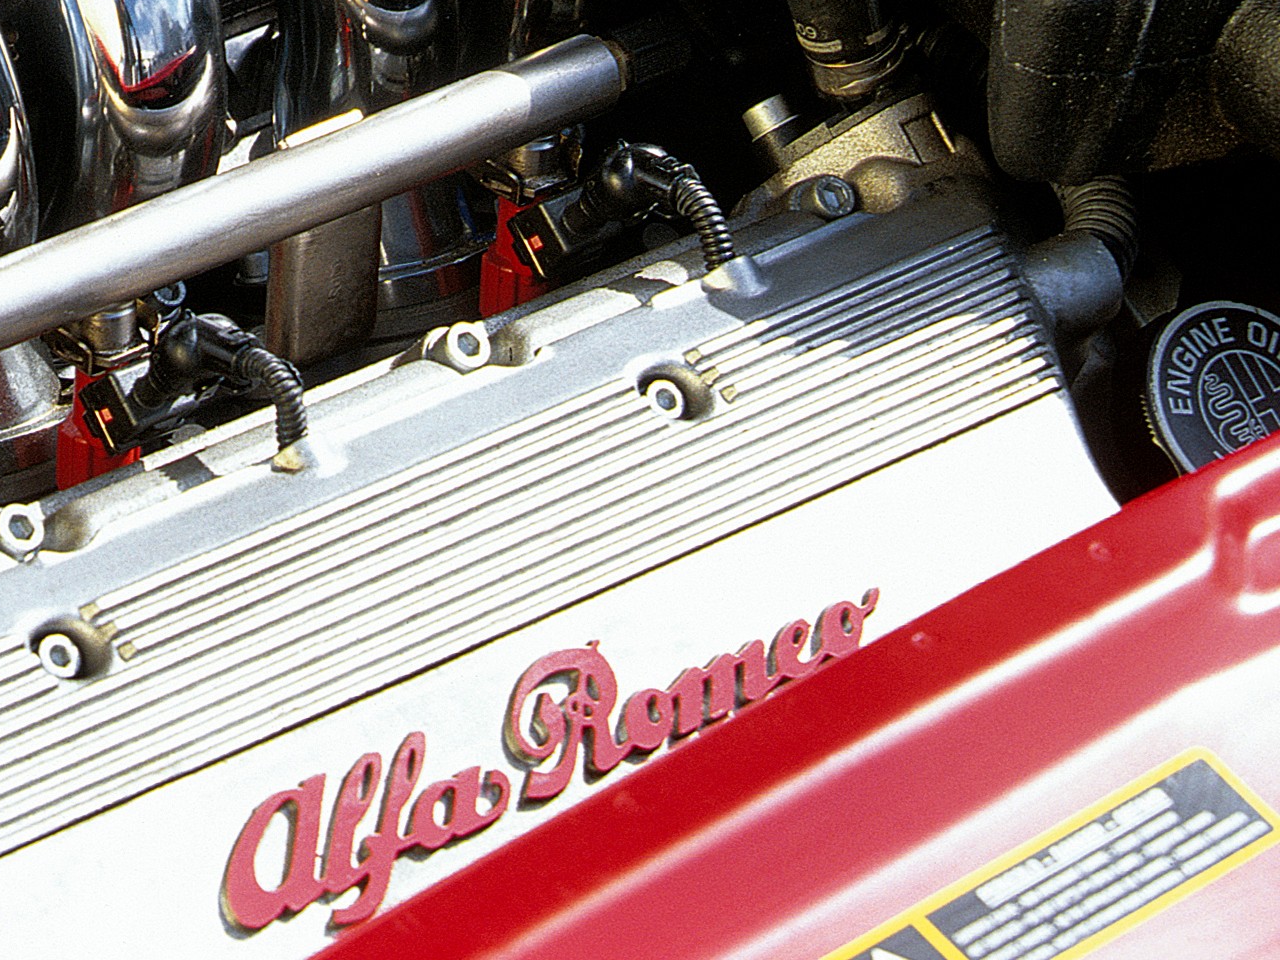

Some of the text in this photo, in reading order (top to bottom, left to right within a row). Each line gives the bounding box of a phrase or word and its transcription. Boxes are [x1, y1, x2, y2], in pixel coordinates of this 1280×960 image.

[1167, 317, 1280, 415] ENGINE OI
[219, 588, 879, 939] Alfa Romeo
